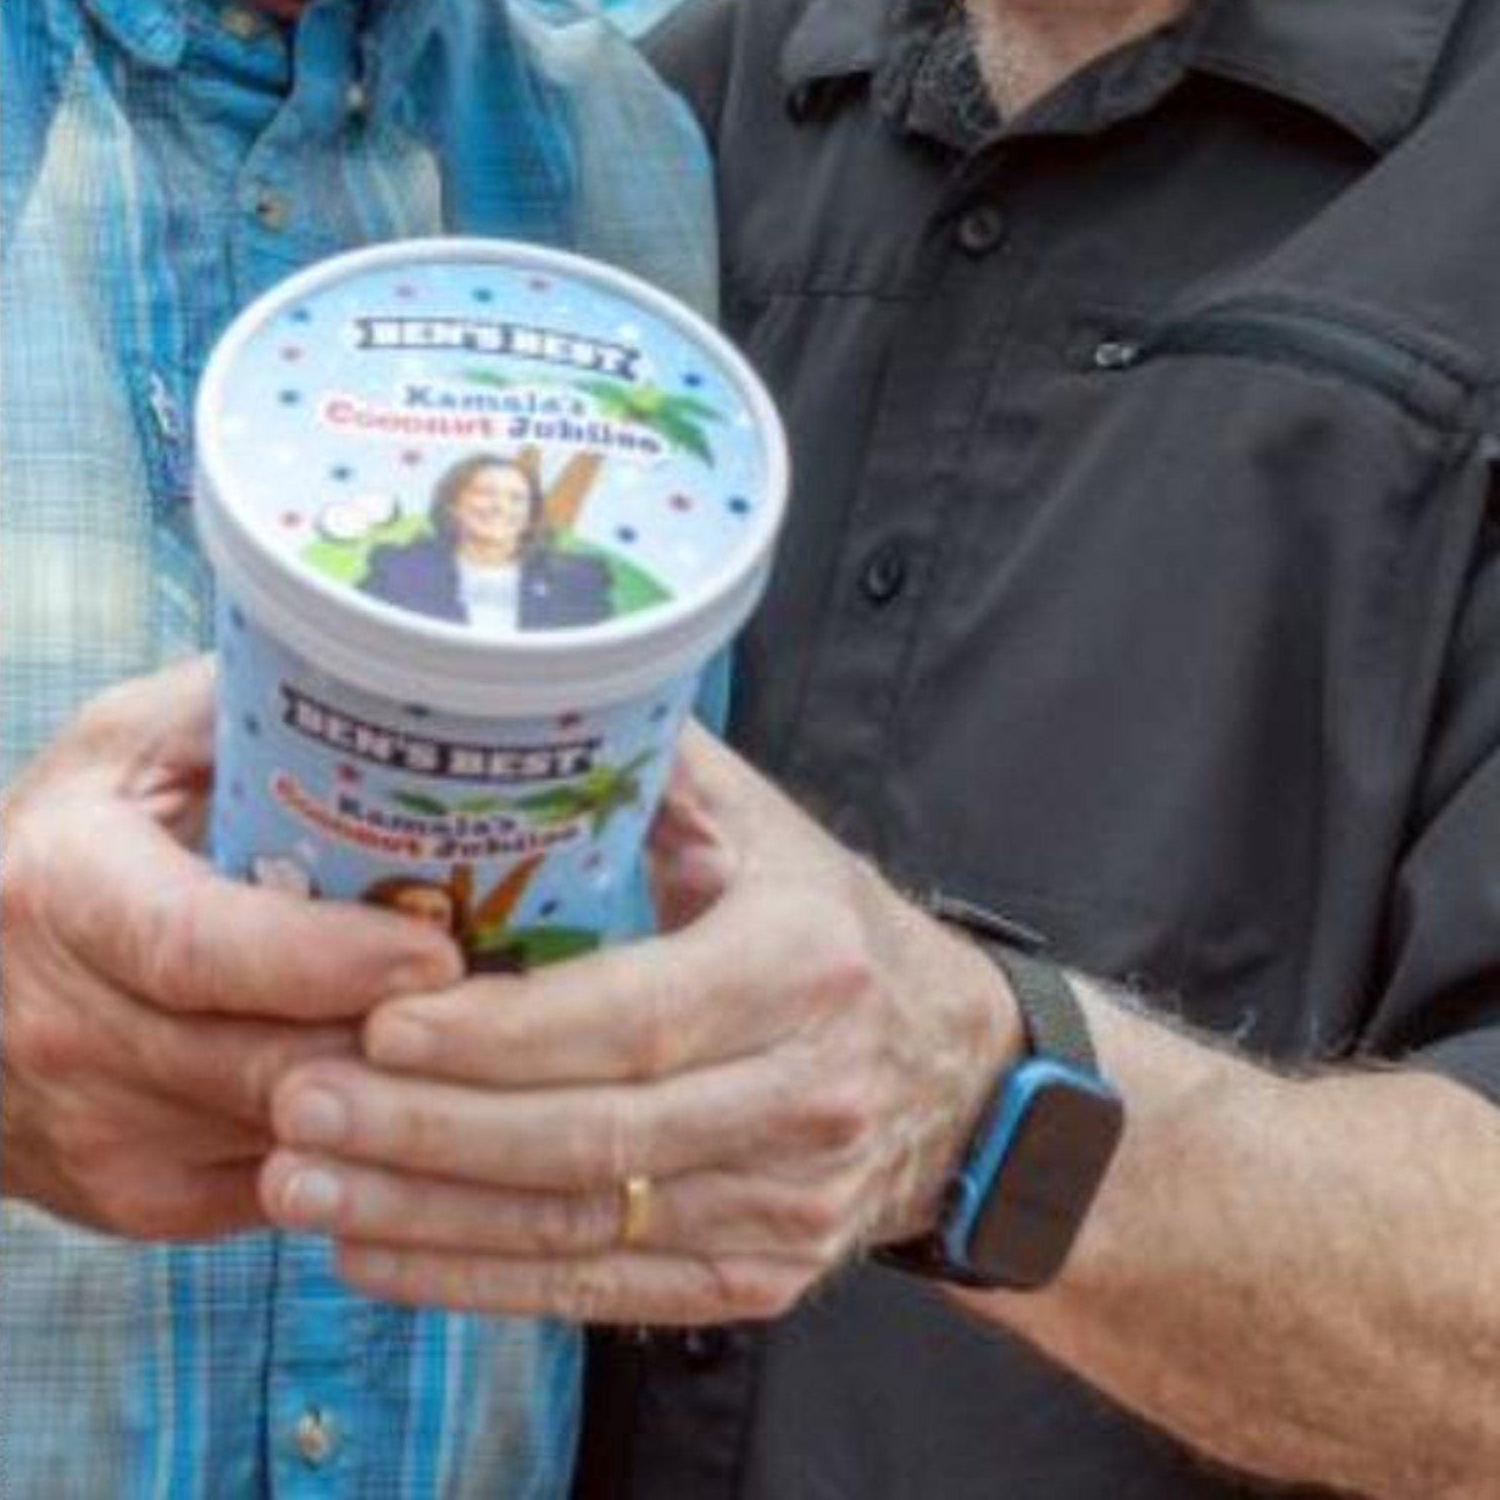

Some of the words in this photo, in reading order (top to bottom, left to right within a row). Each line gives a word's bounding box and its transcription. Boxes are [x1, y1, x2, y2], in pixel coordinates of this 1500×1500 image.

[370, 321, 500, 351] BEN'S
[511, 327, 627, 374] BEST
[404, 384, 585, 414] Kamala's
[325, 400, 493, 436] Coconut
[508, 414, 661, 453] Jubilee
[296, 700, 439, 775] BEN'S
[450, 749, 586, 776] BEST
[337, 793, 516, 838] Kamala's
